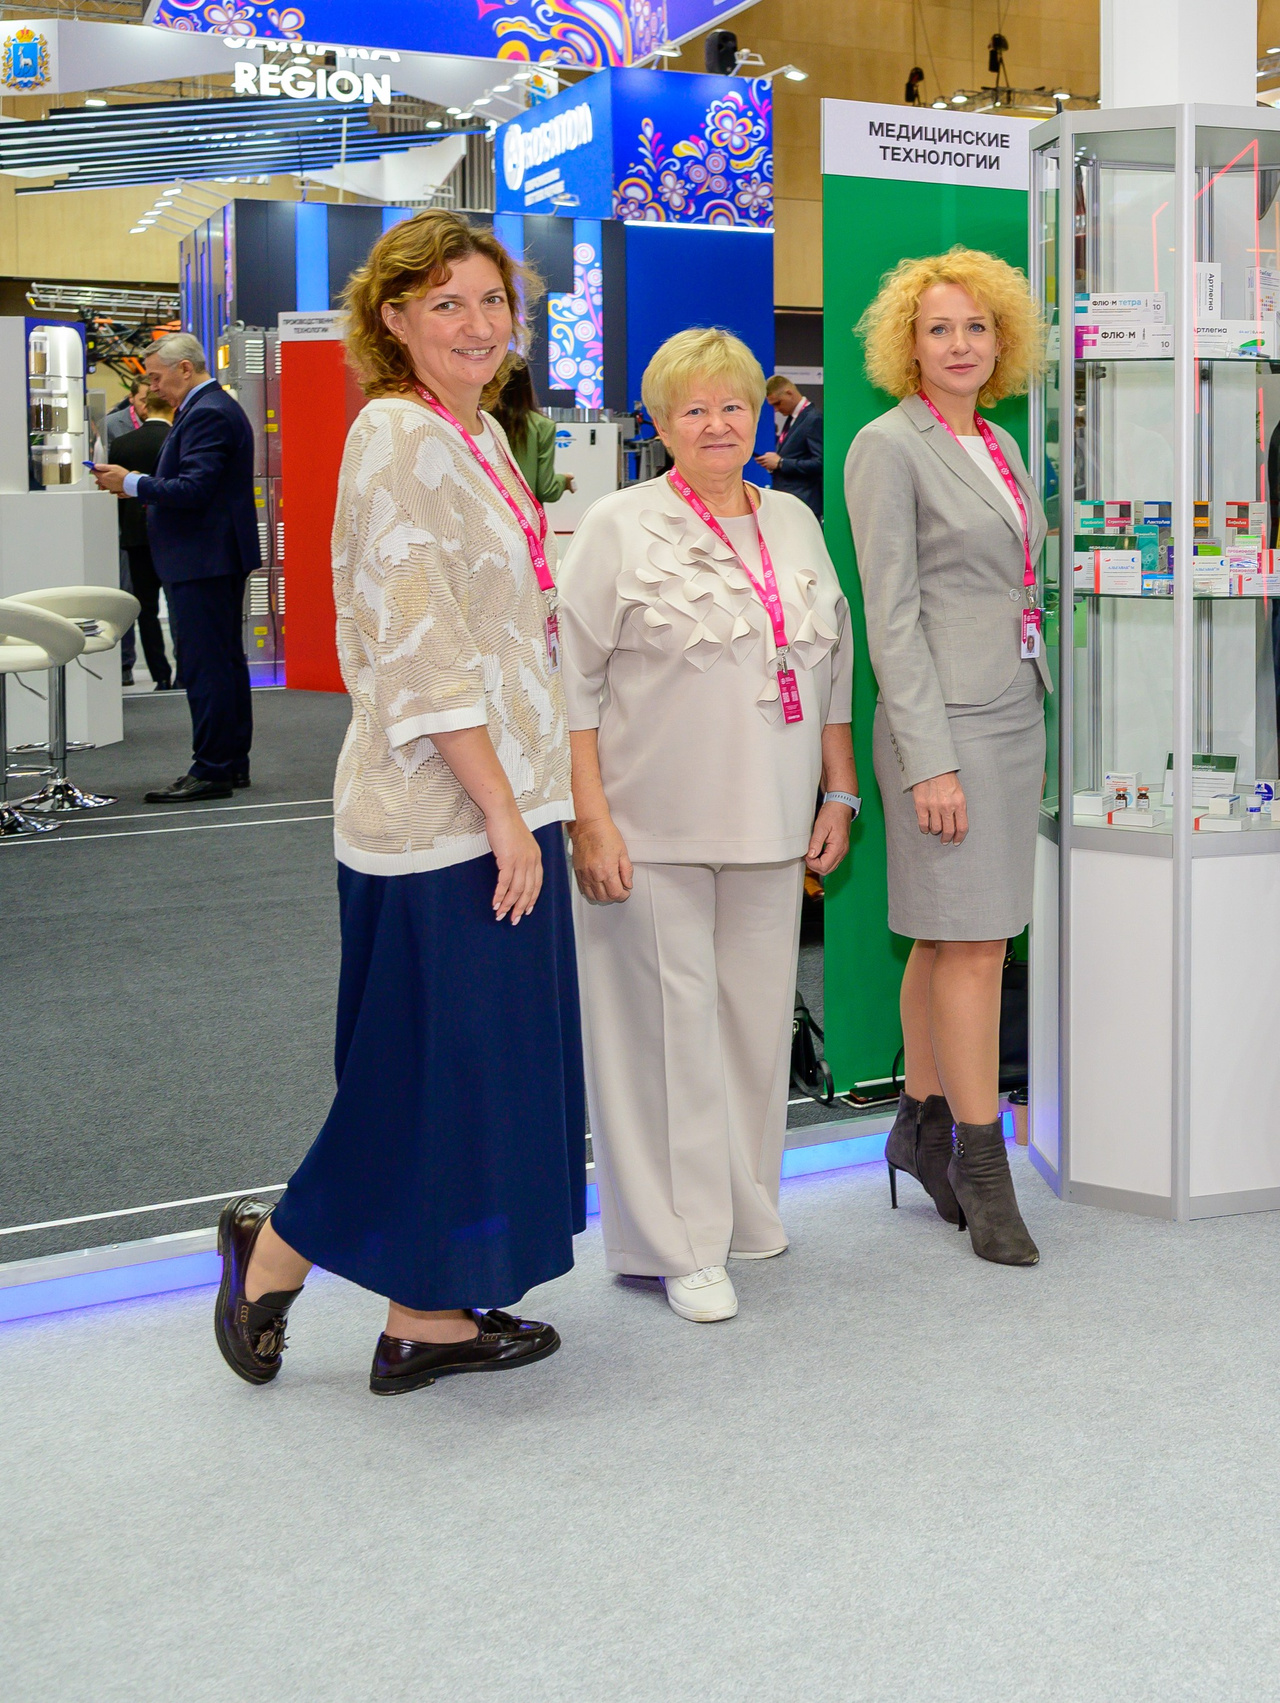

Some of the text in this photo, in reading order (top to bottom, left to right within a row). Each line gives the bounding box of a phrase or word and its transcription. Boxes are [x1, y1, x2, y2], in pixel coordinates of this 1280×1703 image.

[233, 61, 392, 105] REGION
[521, 102, 593, 170] ROSATOM
[868, 121, 1010, 149] МЕДИЦИНСКИЕ
[879, 145, 1000, 170] ТЕХНОЛОГИИ
[283, 317, 335, 325] ПРОИЗВОДСТВЕНН
